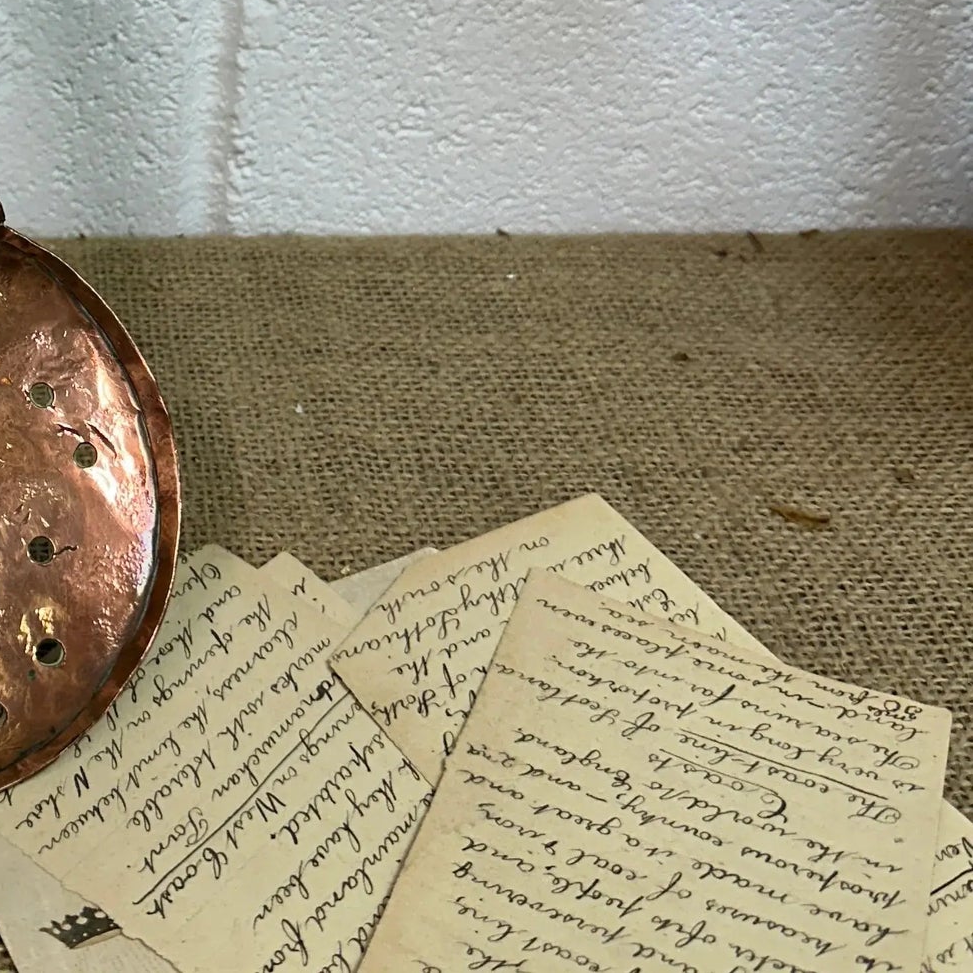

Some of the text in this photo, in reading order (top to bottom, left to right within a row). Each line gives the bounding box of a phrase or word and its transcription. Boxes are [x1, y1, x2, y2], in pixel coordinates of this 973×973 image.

[517, 535, 550, 551] on
[569, 533, 626, 567] three
[465, 549, 511, 583] the
[196, 583, 242, 624] and
[236, 592, 272, 633] the
[376, 566, 472, 625] south
[535, 597, 597, 627] even
[144, 617, 194, 688] those
[437, 627, 492, 660] and
[599, 623, 690, 660] places
[151, 618, 234, 708] openings
[268, 636, 335, 695] marks
[389, 647, 432, 686] the
[439, 661, 474, 700] of
[690, 656, 769, 687] some
[754, 662, 798, 684] the
[566, 637, 921, 771] The sea runs far into the
[808, 679, 880, 706] from
[36, 610, 298, 855] clearness, the limit between
[125, 709, 152, 730] on
[215, 689, 264, 752] with
[619, 710, 661, 741] of
[702, 714, 744, 739] in
[88, 727, 124, 771] the
[746, 721, 816, 761] long
[271, 764, 298, 787] on
[816, 744, 886, 781] very
[124, 739, 217, 833] tolerable
[456, 768, 525, 801] and
[512, 726, 903, 880] in the world to England.
[646, 751, 789, 825] Coasts
[890, 778, 926, 793] is
[13, 784, 65, 830] shore
[224, 790, 287, 850] West
[532, 802, 623, 836] great
[845, 791, 902, 824] The
[251, 764, 398, 930] they have been
[476, 801, 547, 855] iron,
[620, 832, 641, 848] a
[459, 834, 536, 874] and
[564, 847, 648, 881] coal
[643, 846, 676, 866] it
[144, 835, 229, 920] Coast
[542, 863, 645, 919] people,
[640, 869, 693, 902] of
[690, 857, 789, 904] made
[739, 845, 907, 910] prosperous
[450, 859, 626, 945] persevering
[452, 894, 611, 973] coast line,
[801, 902, 909, 947] have
